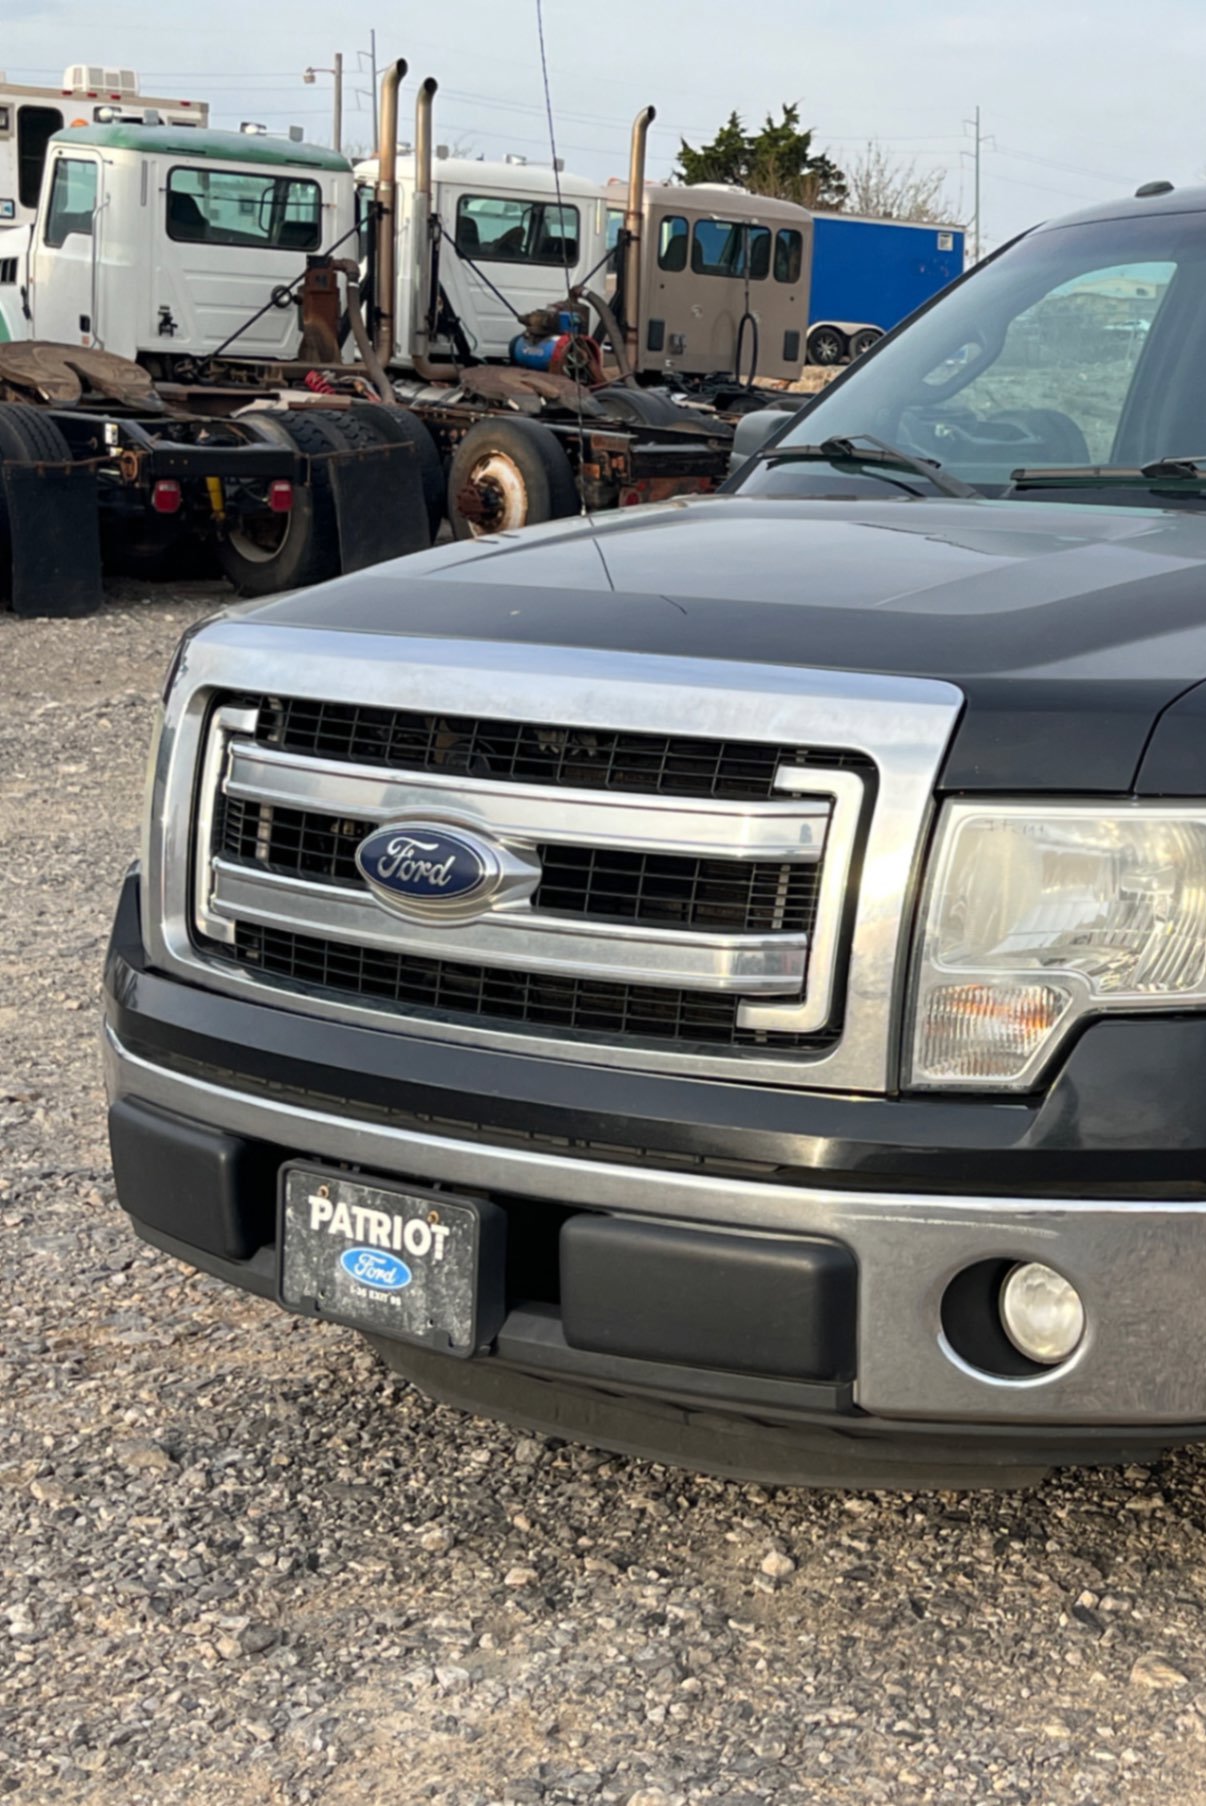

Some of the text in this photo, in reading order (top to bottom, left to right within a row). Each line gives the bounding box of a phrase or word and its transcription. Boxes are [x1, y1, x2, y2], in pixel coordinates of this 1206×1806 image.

[377, 836, 456, 887] Ford
[308, 1195, 450, 1260] PATRIOT
[353, 1252, 397, 1285] Ford
